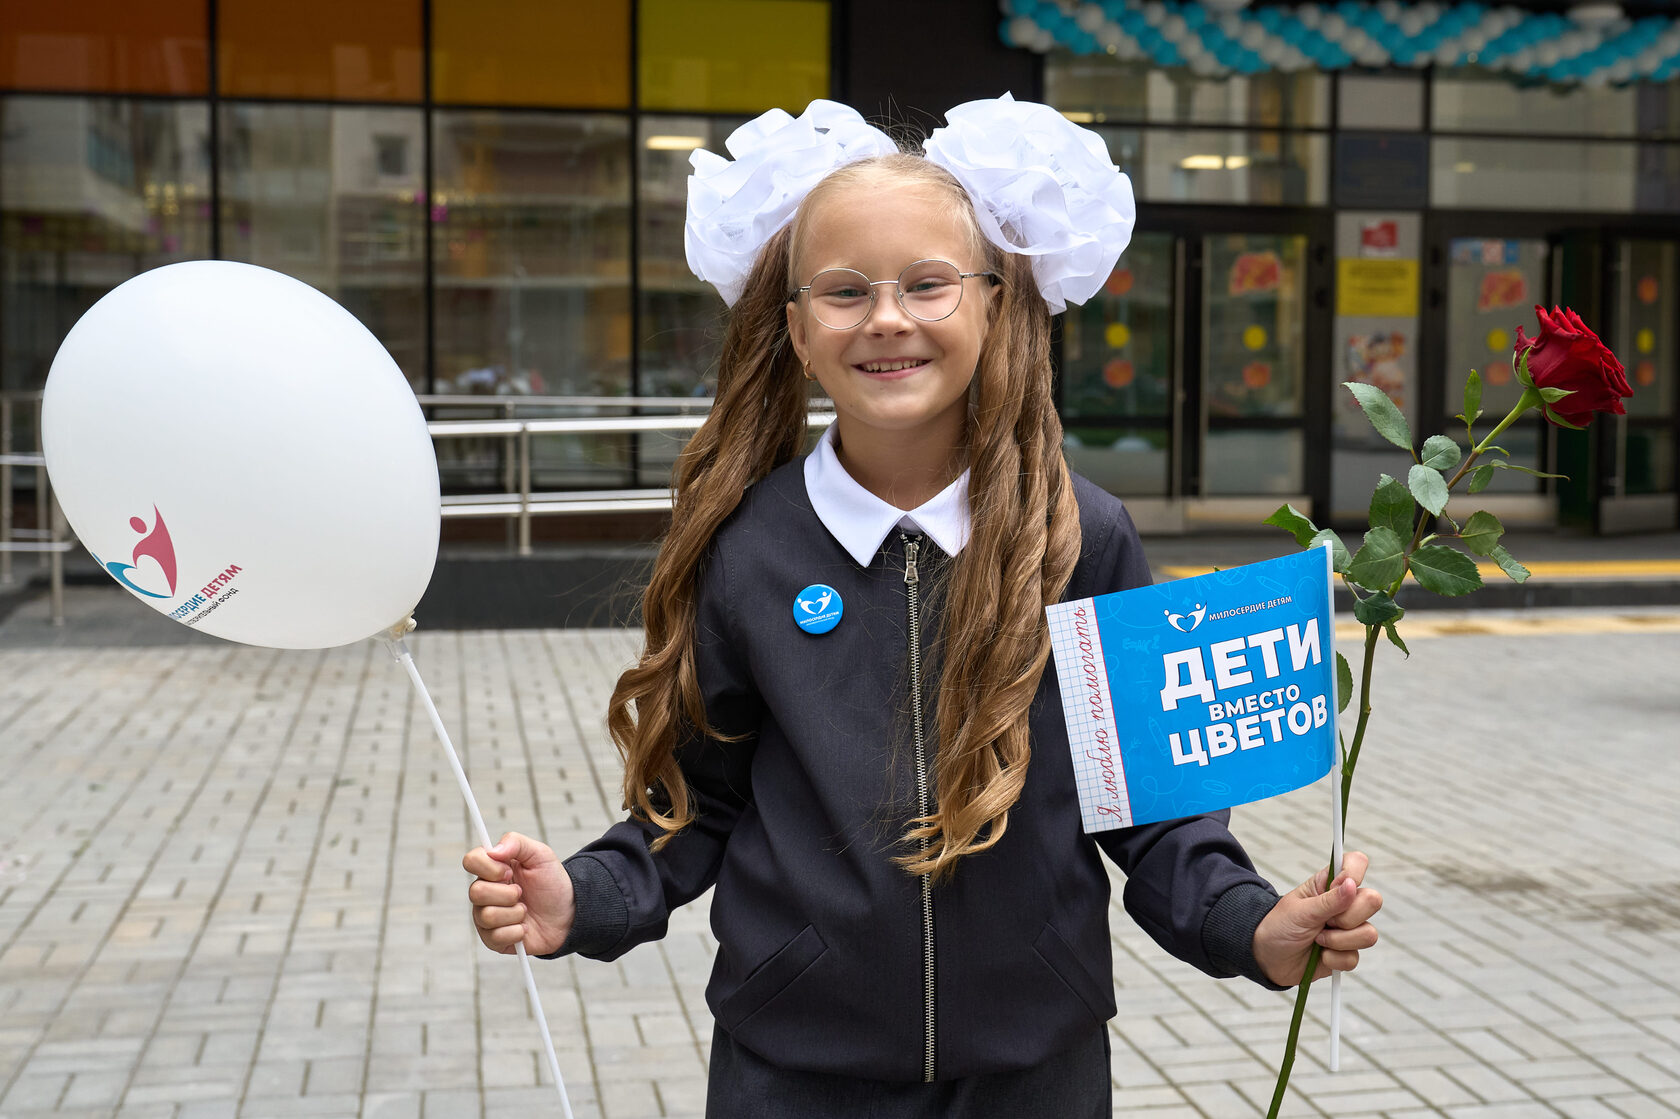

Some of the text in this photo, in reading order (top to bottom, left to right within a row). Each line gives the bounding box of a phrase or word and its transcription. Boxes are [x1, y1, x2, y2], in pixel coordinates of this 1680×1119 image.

[200, 564, 243, 599] ДЕТЯМ
[218, 587, 240, 603] ФОНД
[1209, 595, 1293, 622] МИЛОСЕРДИЕ ДЕТЯМ
[1160, 617, 1322, 712] ДЕТИ
[1077, 606, 1122, 823] Я люблю помогать
[1208, 684, 1301, 722] ВМЕСТО
[1168, 694, 1328, 768] ЦВЕТОВ
